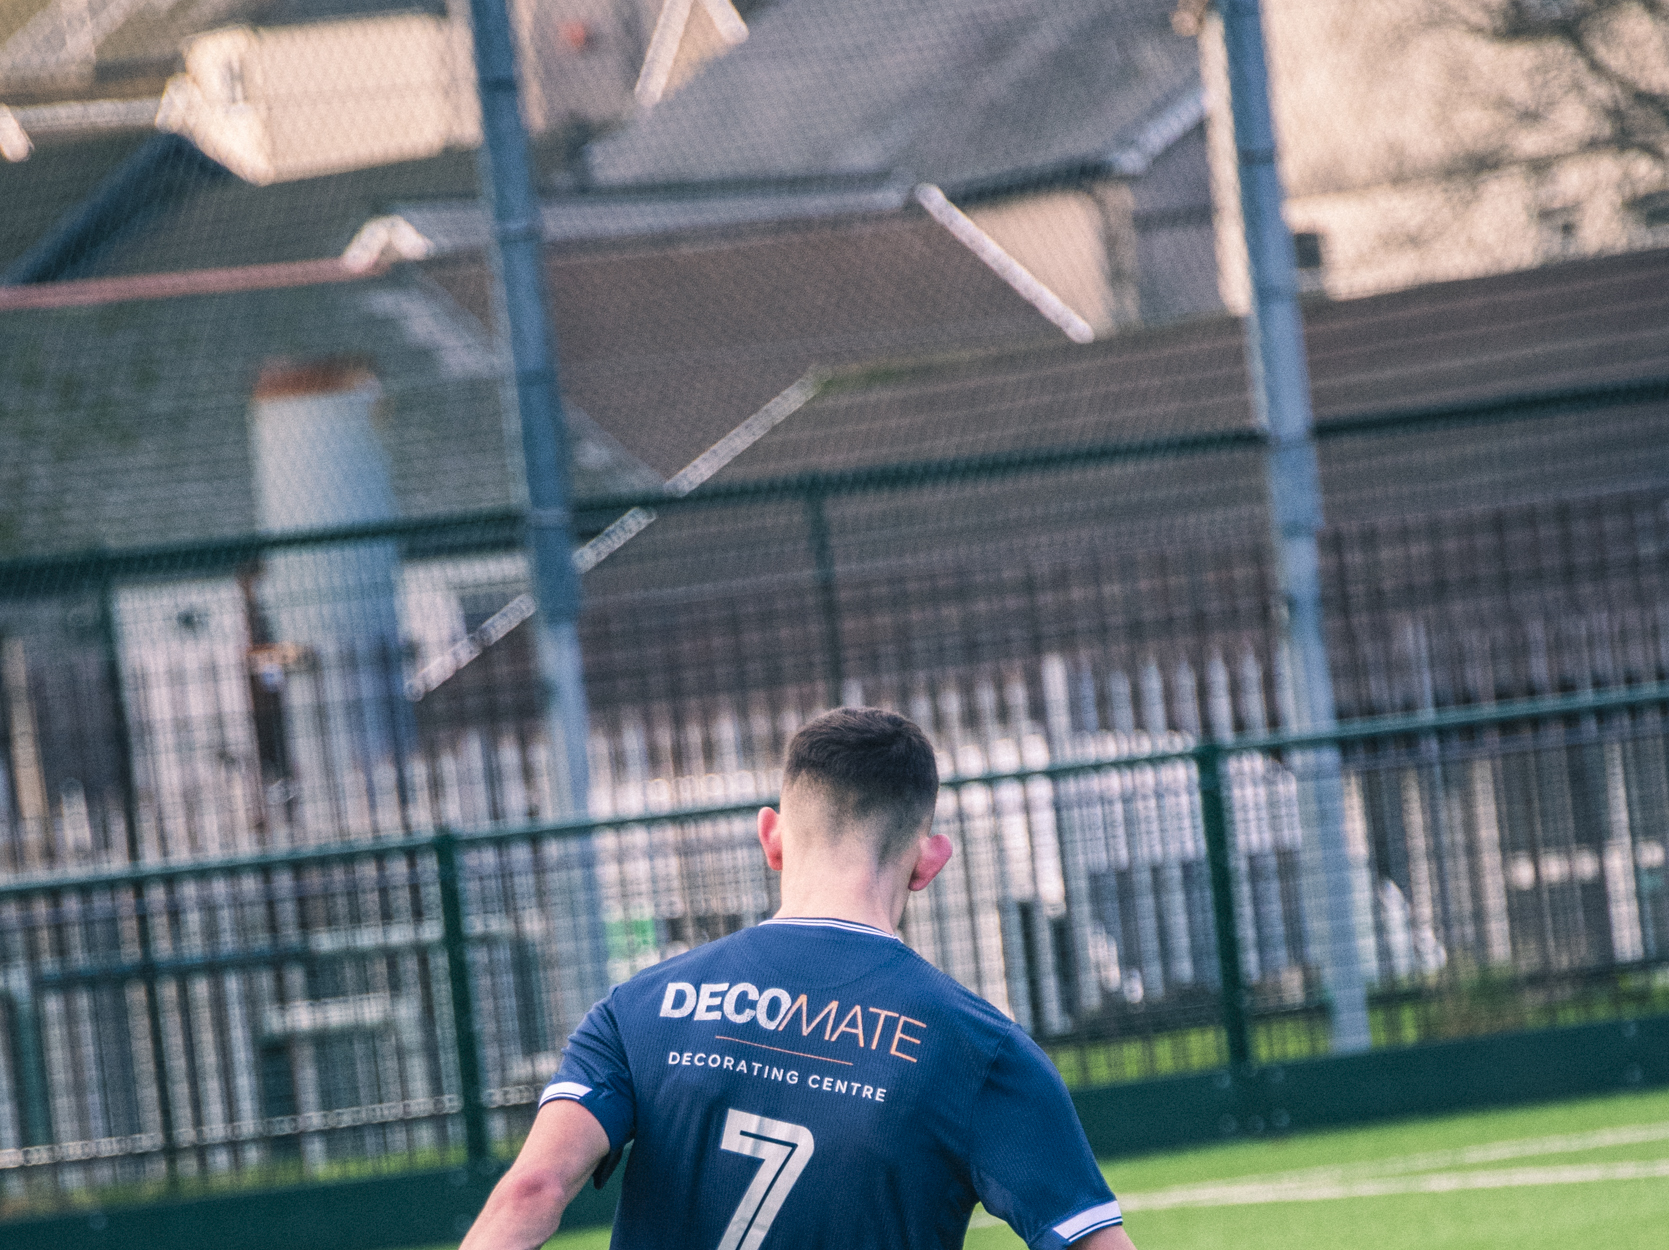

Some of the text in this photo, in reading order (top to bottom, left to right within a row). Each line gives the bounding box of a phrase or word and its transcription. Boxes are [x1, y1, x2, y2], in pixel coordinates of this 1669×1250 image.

[659, 981, 927, 1063] DECOMATE
[667, 1051, 888, 1103] DECORATING CENTRE
